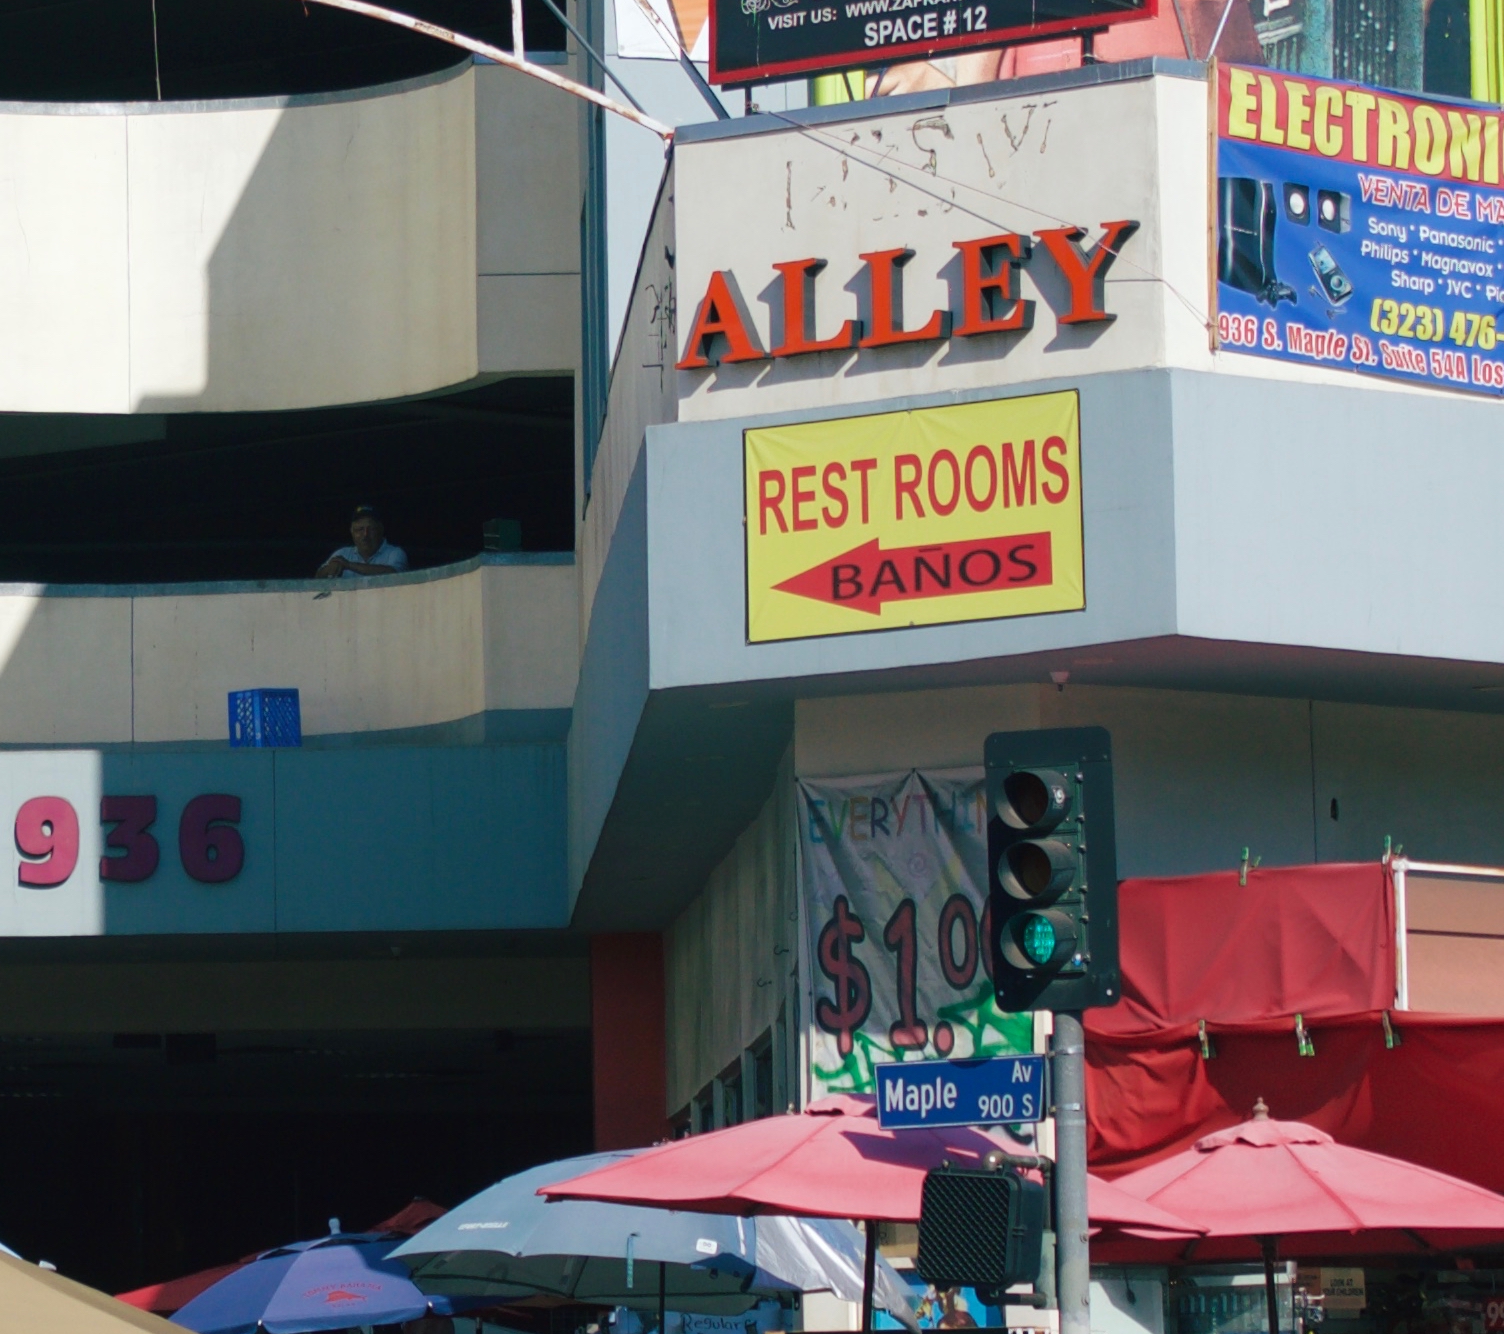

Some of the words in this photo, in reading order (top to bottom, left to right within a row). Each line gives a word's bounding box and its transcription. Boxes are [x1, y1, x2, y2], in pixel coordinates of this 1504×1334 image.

[768, 10, 807, 31] VISIT
[811, 8, 837, 25] US:
[864, 13, 937, 47] SPACE
[943, 12, 958, 34] #
[962, 5, 987, 32] 12
[1358, 173, 1430, 214] VENTA
[1437, 192, 1472, 220] DE
[1368, 216, 1407, 243] Sony
[1419, 224, 1494, 254] Panasonic
[1360, 240, 1409, 265] Philips
[1421, 250, 1493, 278] Magnavox
[675, 219, 1139, 370] ALLEY
[1391, 269, 1434, 296] Sharp
[1446, 278, 1472, 299] JVC
[1370, 297, 1445, 342] (323)
[1218, 315, 1256, 344] 936
[1264, 321, 1282, 349] S.
[1286, 323, 1345, 361] Maple
[1382, 344, 1426, 375] Suite
[1431, 353, 1468, 380] 54A
[1473, 356, 1504, 387] Los
[759, 458, 877, 535] REST
[895, 436, 1070, 522] ROOMS
[830, 543, 1039, 602] BAÑOS
[14, 793, 245, 890] 936
[885, 1078, 958, 1119] Maple
[1012, 1060, 1033, 1084] Av
[978, 1094, 1014, 1119] 900
[1022, 1093, 1034, 1116] S
